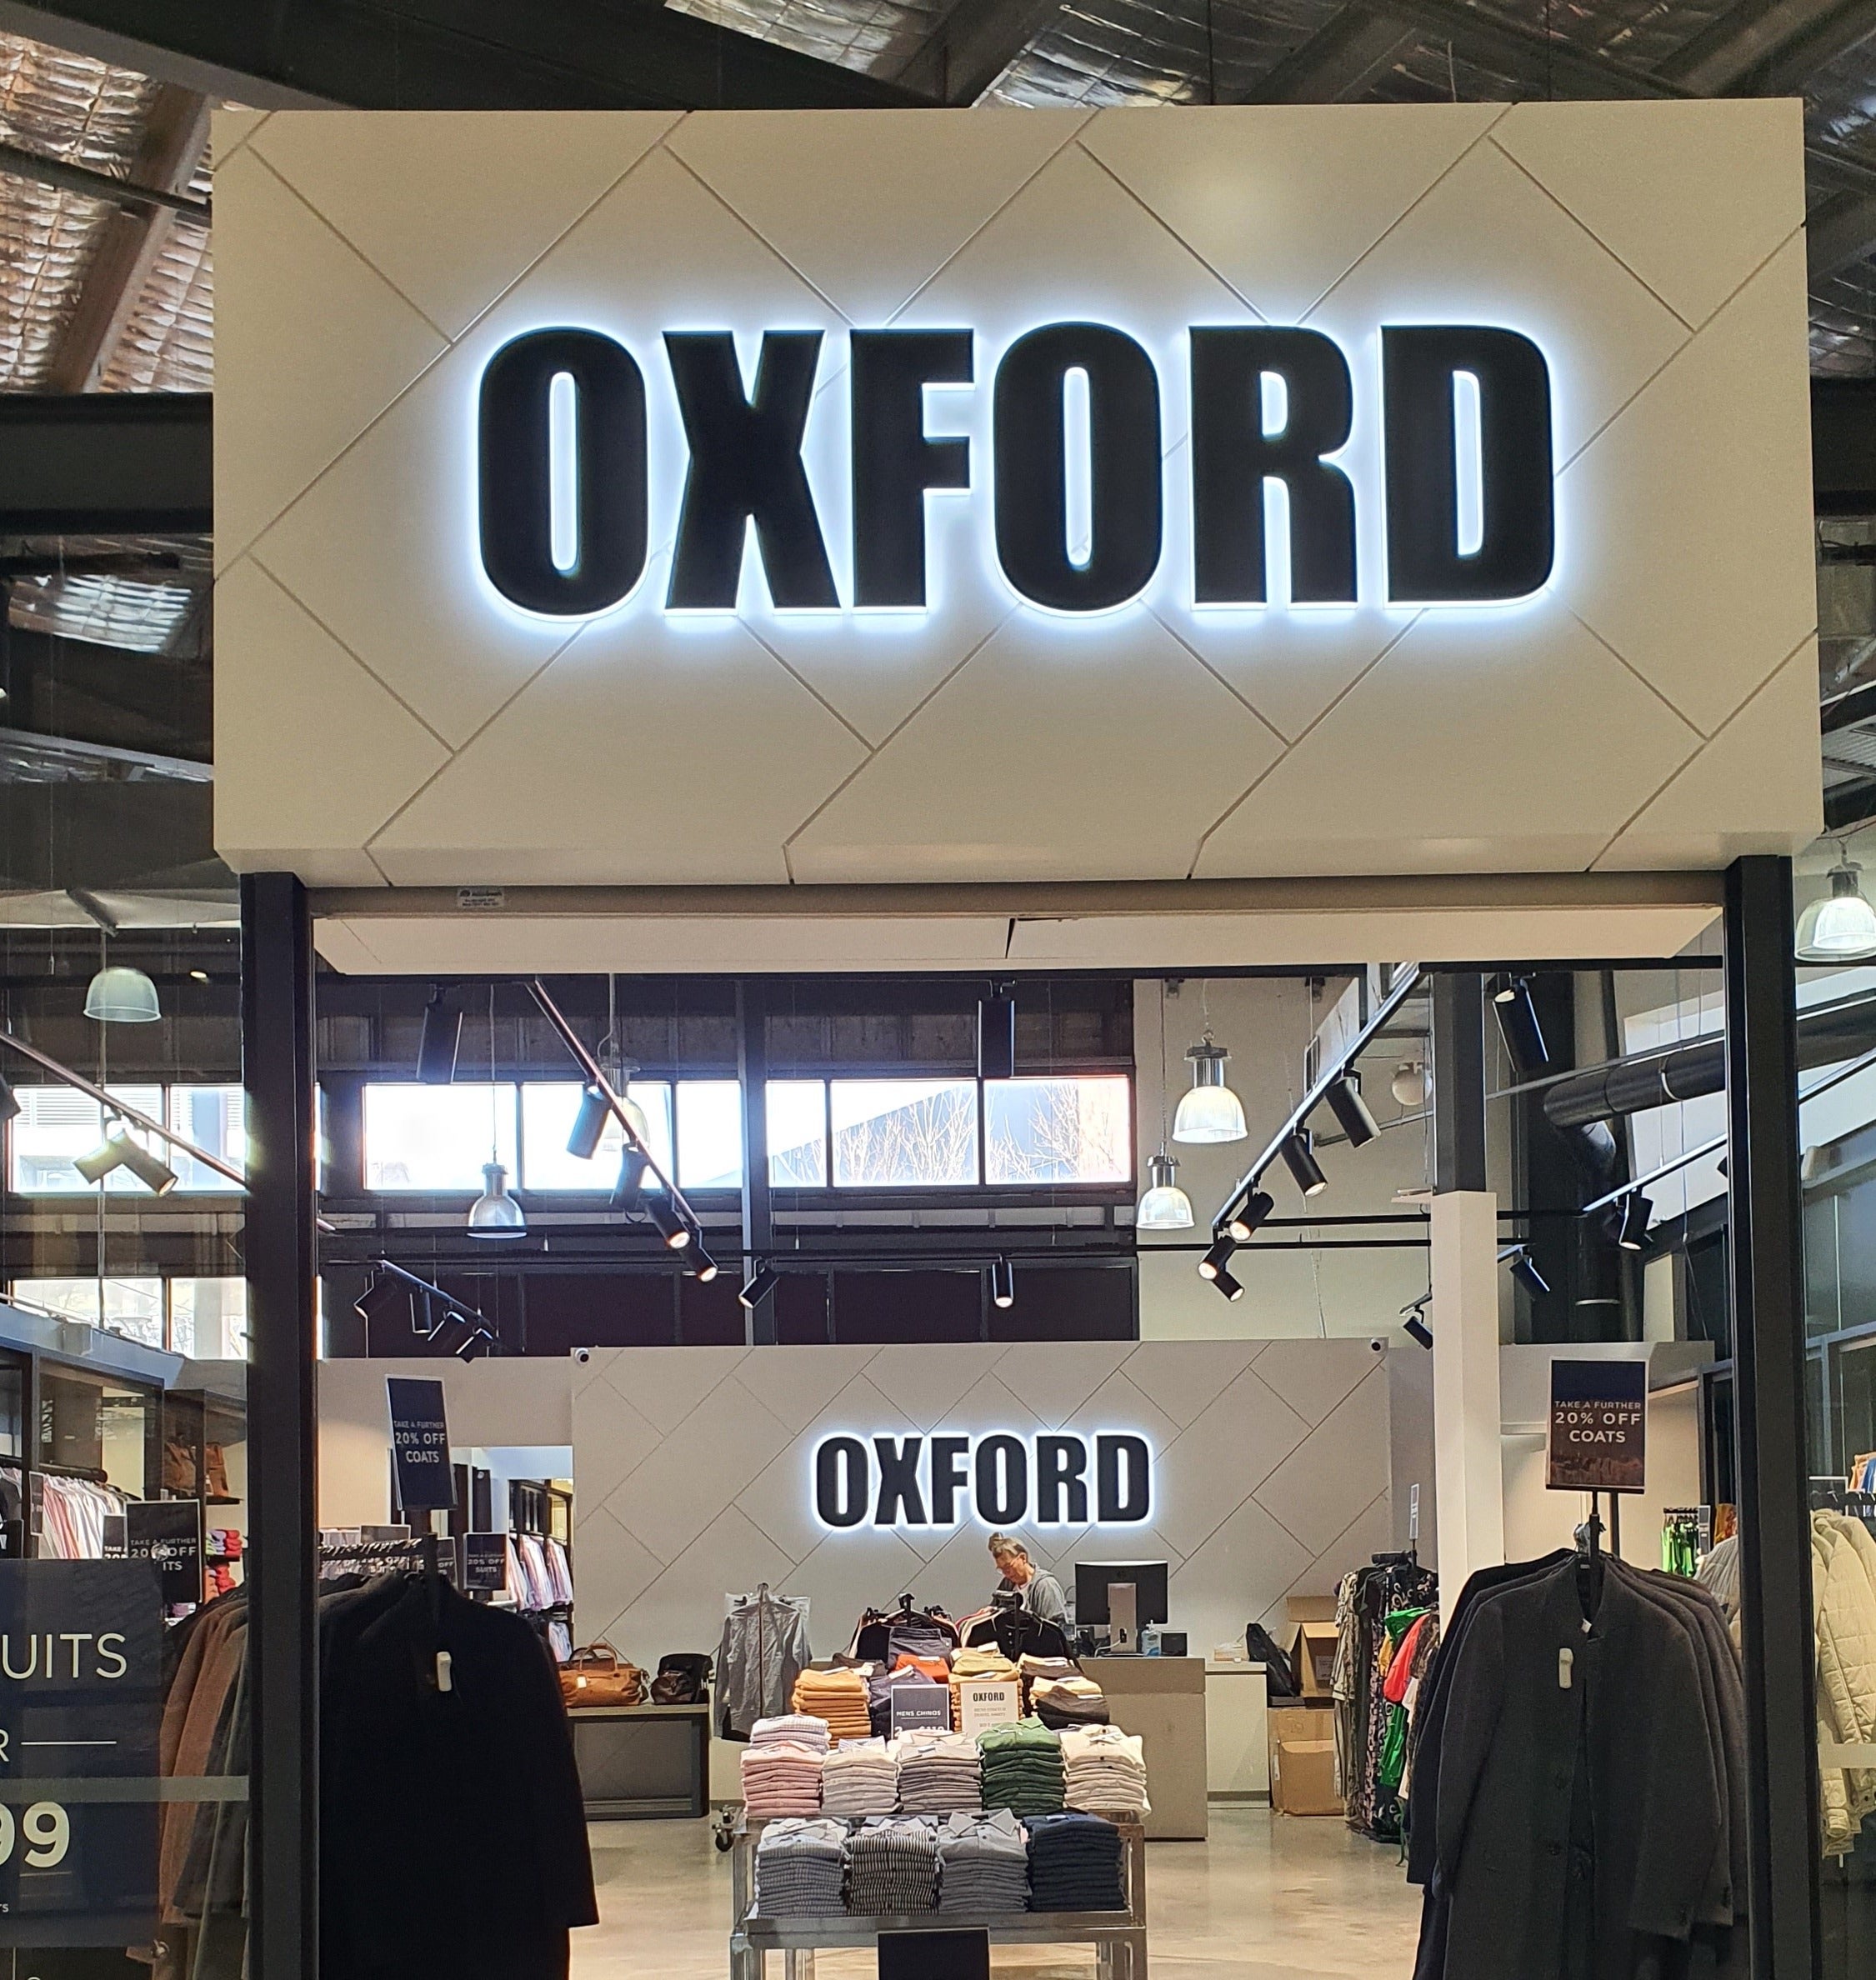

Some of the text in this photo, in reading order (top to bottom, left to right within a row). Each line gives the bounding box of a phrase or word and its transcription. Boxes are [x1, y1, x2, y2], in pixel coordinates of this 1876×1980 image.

[478, 322, 1553, 614] OXFORD
[1554, 1400, 1580, 1408] TAKE
[1594, 1401, 1641, 1409] FURTHER
[1555, 1412, 1641, 1425] 20% OFF
[417, 1421, 444, 1429] FURTHER
[395, 1432, 446, 1445] 20% OFF
[1569, 1430, 1626, 1442] COATS
[405, 1451, 440, 1463] COATS
[816, 1434, 1149, 1527] OXFORD
[168, 1547, 196, 1557] OFF
[163, 1561, 183, 1571] ITS
[973, 1692, 1004, 1702] OXFORD
